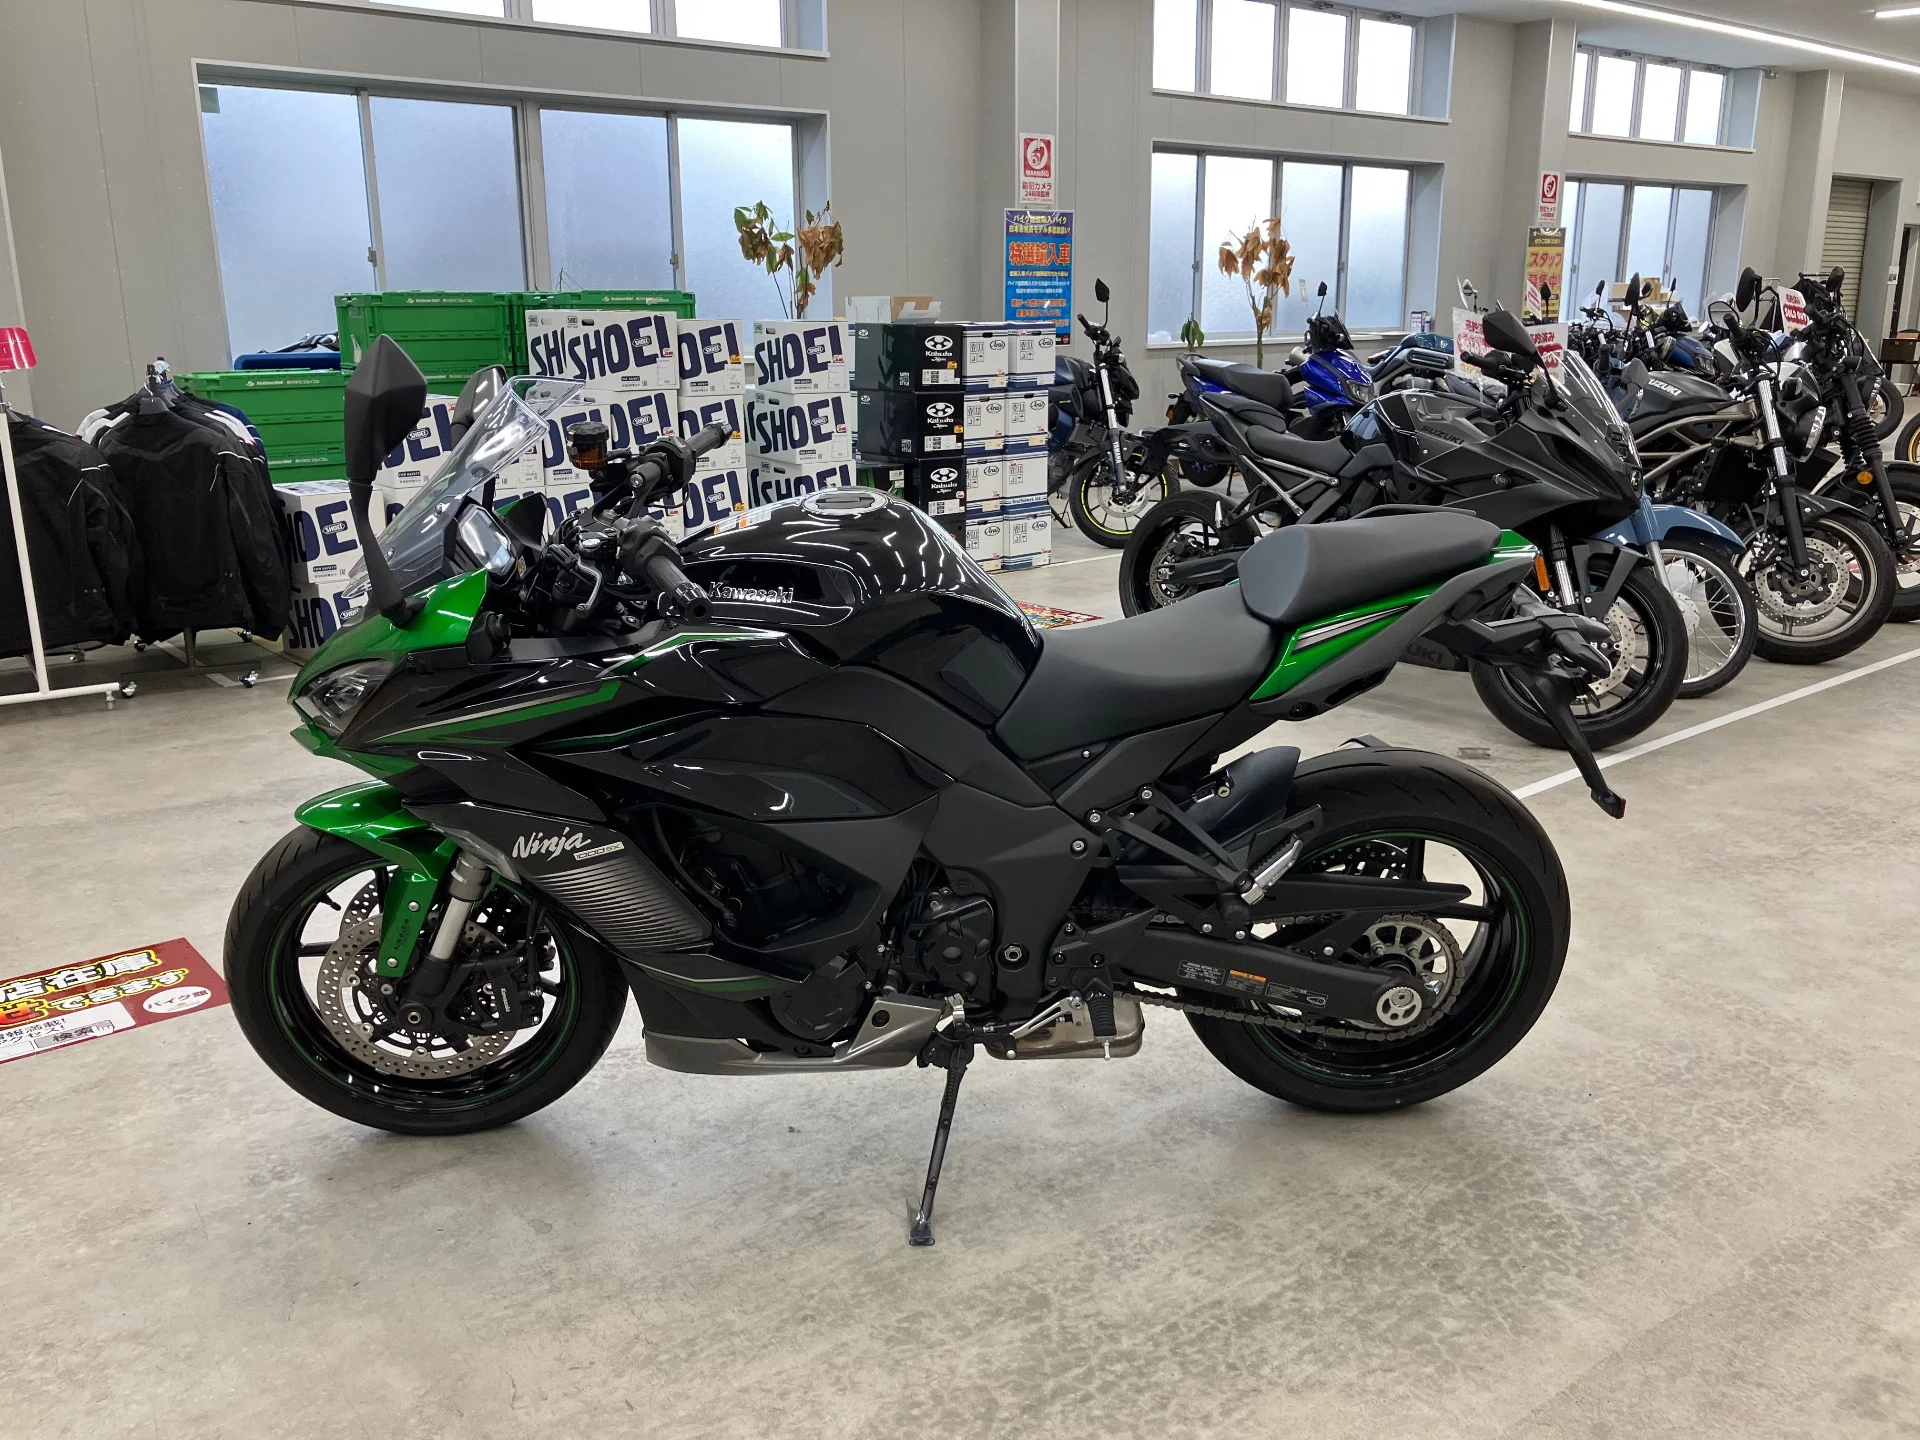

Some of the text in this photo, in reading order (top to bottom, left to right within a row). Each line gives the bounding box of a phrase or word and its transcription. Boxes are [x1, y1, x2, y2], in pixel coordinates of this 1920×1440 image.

[1022, 181, 1052, 190] 防犯カメラ
[1009, 241, 1070, 266] 特選輸入車
[1529, 252, 1562, 267] スタッフ
[568, 315, 671, 380] SHOEI
[991, 340, 1005, 349] Arai
[1040, 338, 1053, 347] Arai
[755, 325, 843, 386] SHOEI
[988, 403, 1001, 412] Arai
[1032, 400, 1045, 409] Arai
[756, 396, 845, 454] SHOEI
[406, 429, 429, 440] SHOEI
[1420, 425, 1465, 445] SUZUKI
[985, 466, 999, 475] Arai
[322, 521, 348, 534] SHOEI
[985, 526, 1000, 535] Arai
[1033, 522, 1047, 530] Arai
[708, 581, 793, 603] Kawasaki
[512, 827, 592, 861] Ninja
[576, 844, 622, 859] 1000SX
[148, 990, 209, 1009] バイク館
[53, 1026, 96, 1042] 検索
